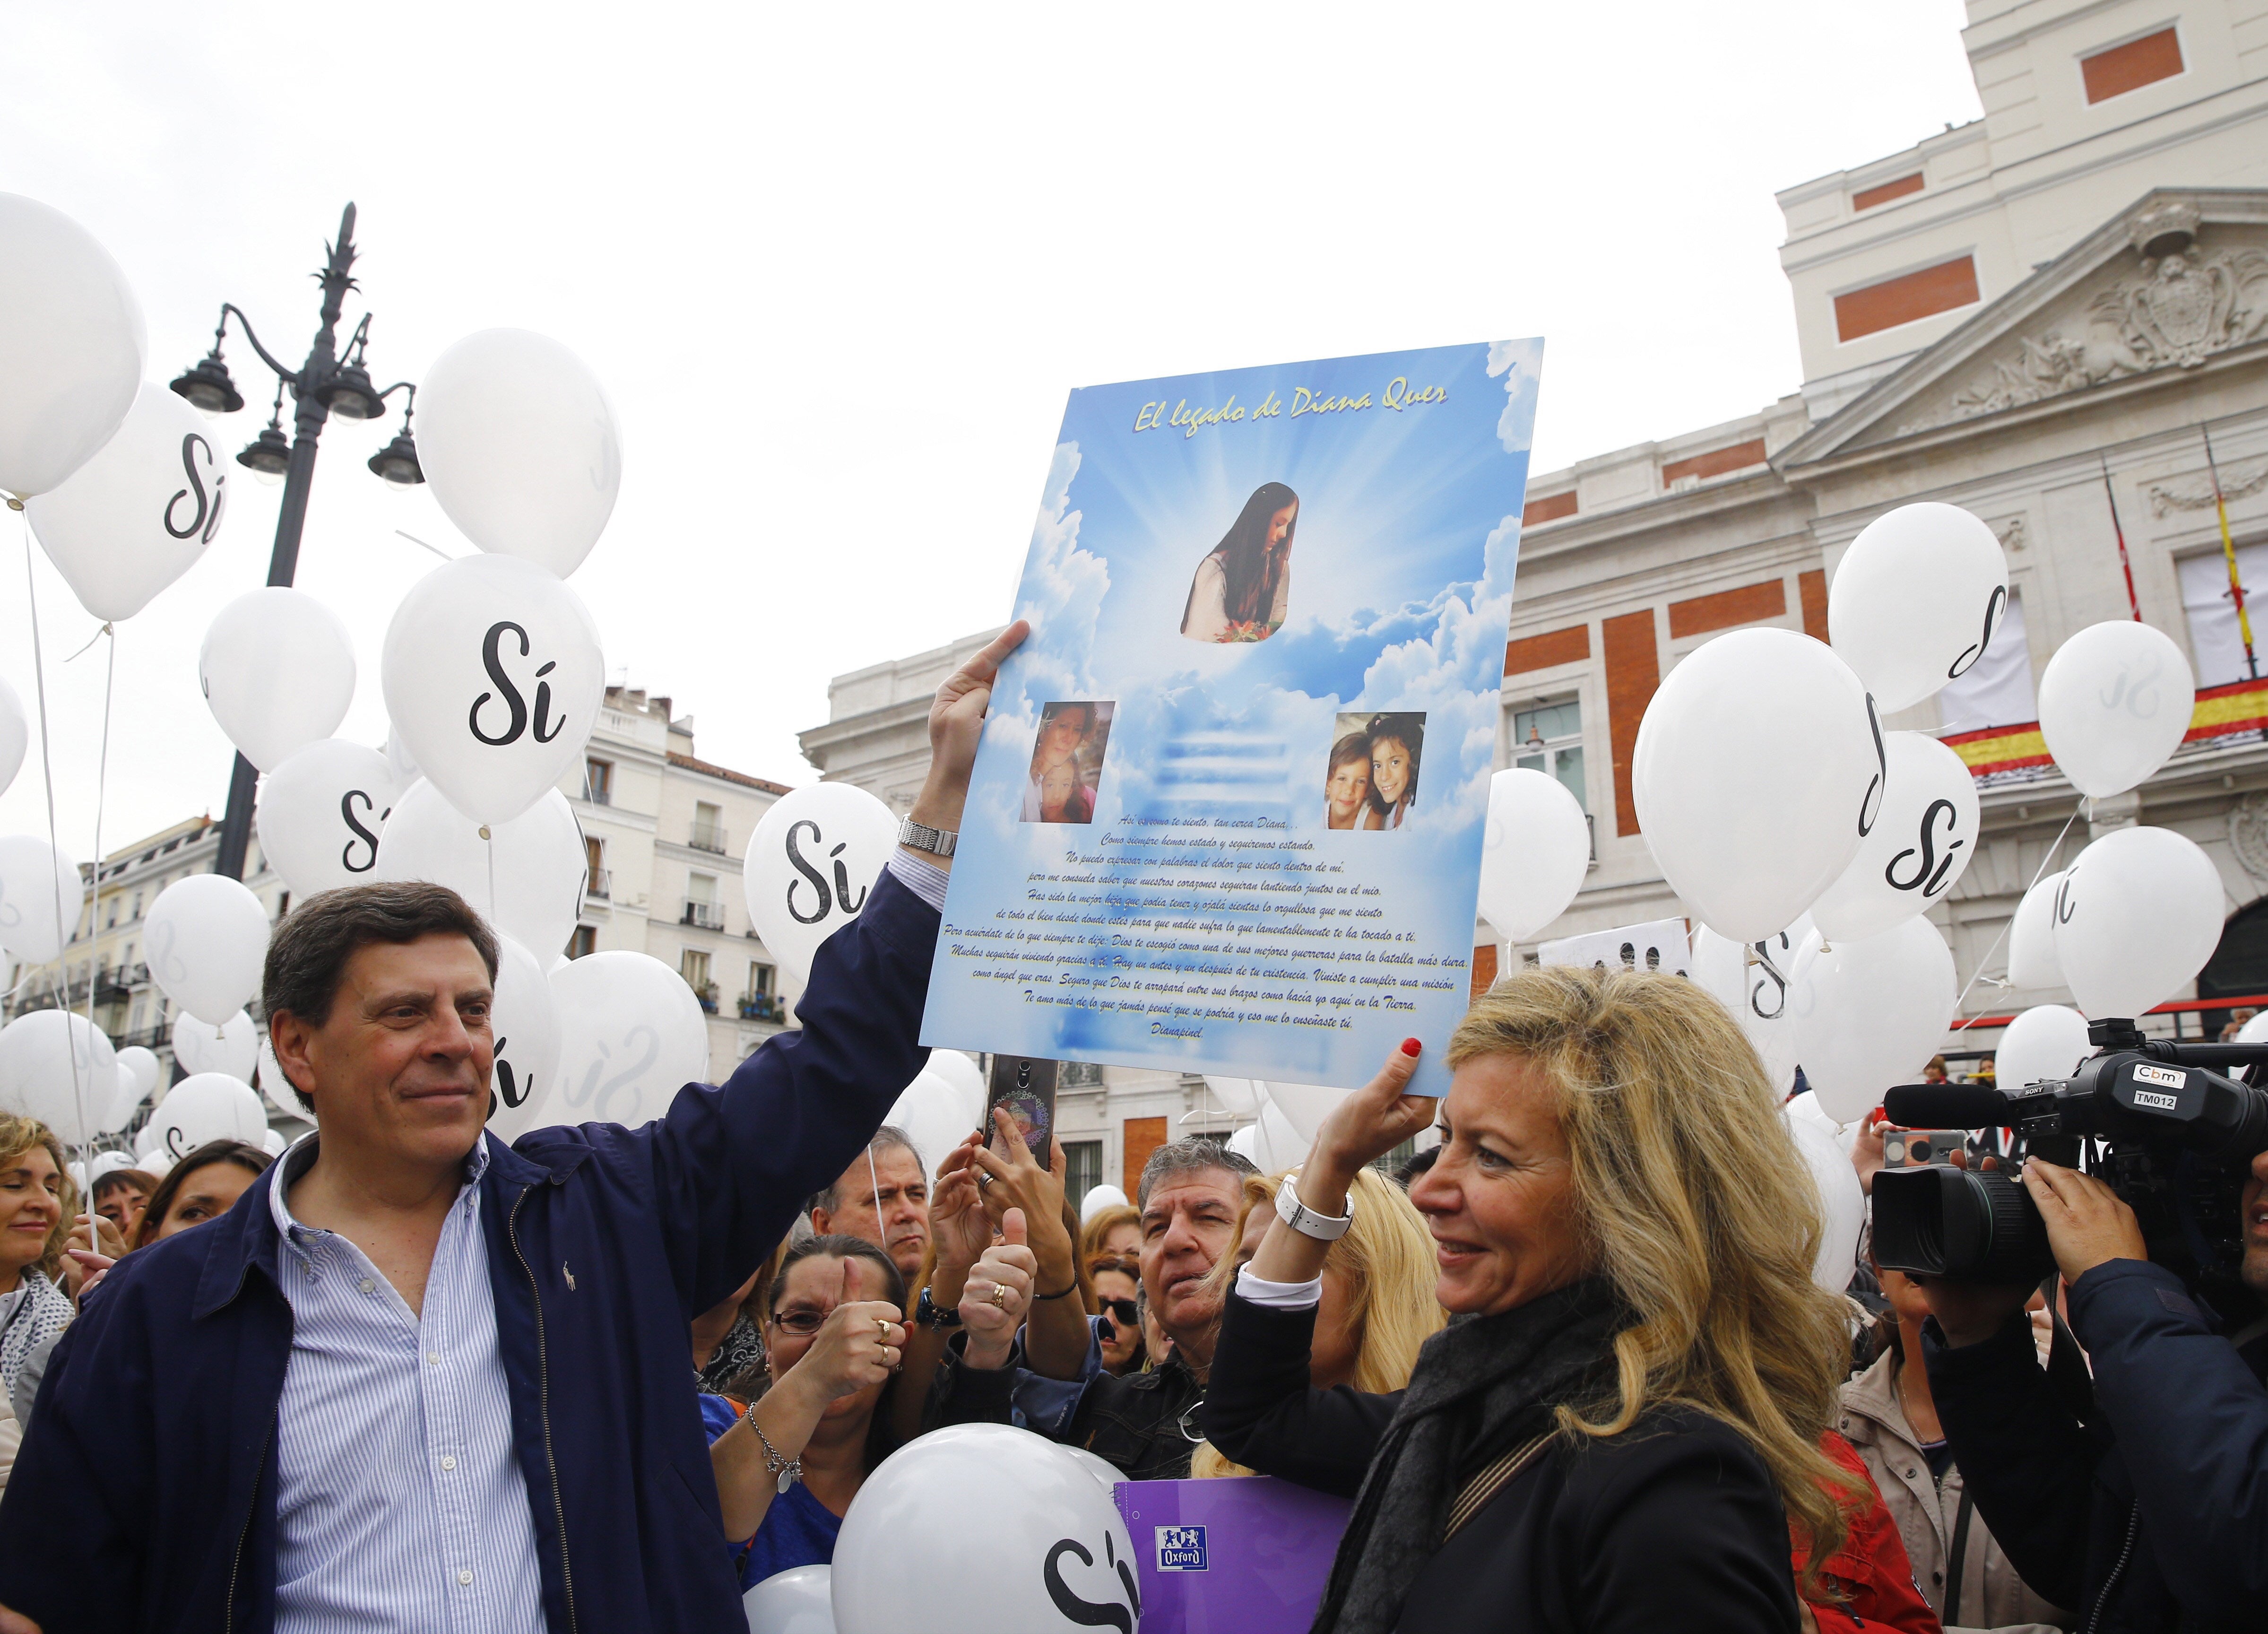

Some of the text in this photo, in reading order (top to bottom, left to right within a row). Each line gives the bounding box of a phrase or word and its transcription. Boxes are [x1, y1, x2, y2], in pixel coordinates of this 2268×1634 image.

[1134, 377, 1448, 439] El legado de Diana Quer
[469, 621, 566, 746] Sí
[341, 790, 390, 872] S
[1119, 814, 1137, 825] Así
[1182, 817, 1209, 827] siento,
[1213, 817, 1230, 827] tan
[1231, 820, 1255, 828] cerca
[1101, 832, 1124, 845] Como
[1126, 835, 1160, 848] siempre
[1161, 834, 1187, 846] hemos
[1189, 836, 1217, 847] estado
[1229, 839, 1276, 852] seguiremos
[1885, 799, 1964, 898] Sí
[786, 820, 867, 924] Sí
[1065, 850, 1078, 863] No
[1078, 853, 1105, 866] puedo
[1107, 855, 1142, 868] expresar
[1158, 855, 1198, 869] palabras
[1211, 857, 1234, 869] dolor
[1236, 861, 1253, 873] que
[1255, 860, 1281, 870] siento
[1283, 860, 1312, 871] dentro
[1315, 860, 1327, 872] de
[1028, 873, 1046, 883] pero
[1062, 872, 1096, 883] consuela
[1098, 872, 1120, 884] saber
[1122, 877, 1138, 889] que
[1140, 877, 1174, 887] nuestros
[1177, 880, 1217, 892] corazones
[1260, 879, 1302, 893] lantiendo
[1303, 882, 1333, 896] juntos
[1336, 887, 1348, 895] en
[1350, 883, 1361, 895] el
[1028, 888, 1046, 901] Has
[1047, 891, 1065, 902] sido
[1067, 891, 1076, 903] la
[1079, 894, 1102, 907] mejor
[1169, 898, 1191, 909] tener
[1202, 898, 1227, 912] ojalá
[1228, 901, 1260, 912] sientas
[1274, 902, 1316, 917] orgullosa
[1319, 907, 1336, 920] que
[1355, 907, 1383, 918] siento
[996, 908, 1006, 919] de
[1008, 909, 1025, 920] todo
[1037, 909, 1054, 921] bien
[1056, 911, 1080, 923] desde
[1081, 913, 1106, 924] donde
[1108, 913, 1128, 925] estés
[1129, 917, 1152, 929] para
[1154, 920, 1170, 932] que
[1172, 918, 1197, 930] nadie
[1199, 919, 1223, 935] sufra
[1237, 925, 1254, 937] que
[1256, 921, 1331, 937] lamentablemente
[1333, 928, 1343, 938] te
[1345, 925, 1358, 939] ha
[1361, 929, 1392, 940] tocado
[944, 923, 963, 936] Pero
[965, 926, 1003, 939] acuérdate
[1004, 929, 1015, 939] de
[1017, 929, 1025, 940] lo
[1027, 933, 1042, 945] que
[1043, 932, 1075, 946] siempre
[1088, 933, 1109, 948] dije:
[1111, 934, 1132, 947] Dios
[1146, 938, 1177, 953] escogió
[1178, 943, 1200, 951] como
[1202, 944, 1220, 952] una
[1222, 942, 1234, 953] de
[1236, 946, 1251, 954] sus
[1254, 945, 1289, 959] mejores
[1291, 949, 1335, 961] guerreras
[1337, 951, 1362, 963] para
[1378, 950, 1414, 965] batalla
[1417, 953, 1438, 966] más
[952, 943, 983, 957] Muchas
[985, 948, 1020, 962] seguirán
[1021, 951, 1054, 962] viviendo
[1056, 955, 1088, 967] gracias
[1112, 955, 1133, 969] Hay
[1135, 961, 1147, 969] un
[1149, 960, 1172, 971] antes
[1183, 964, 1196, 973] un
[1198, 962, 1233, 977] después
[1236, 965, 1247, 976] de
[1250, 966, 1260, 977] tu
[1313, 968, 1347, 983] Viniste
[1359, 973, 1397, 989] cumplir
[1400, 979, 1419, 988] una
[1421, 977, 1454, 990] misión
[972, 970, 992, 978] como
[994, 967, 1018, 983] ángel
[1017, 973, 1033, 984] que
[1059, 973, 1090, 989] Seguro
[1092, 979, 1108, 991] que
[1110, 975, 1131, 989] Dios
[1133, 980, 1143, 990] te
[1144, 981, 1186, 995] arropará
[1186, 984, 1209, 995] entre
[1211, 987, 1227, 996] sus
[1229, 984, 1258, 1002] brazos
[1261, 991, 1283, 1000] como
[1286, 989, 1312, 1003] hacía
[1330, 993, 1353, 1009] aquí
[1354, 999, 1366, 1007] en
[1368, 995, 1380, 1008] la
[1024, 990, 1035, 1002] Te
[1036, 995, 1054, 1004] amo
[1056, 994, 1074, 1005] más
[1099, 1000, 1116, 1012] que
[1117, 1000, 1145, 1012] jamás
[1146, 1002, 1173, 1015] pensé
[1174, 1007, 1190, 1018] que
[1192, 1008, 1203, 1016] se
[1203, 1007, 1235, 1020] podría
[1247, 1012, 1262, 1021] eso
[1264, 1015, 1278, 1023] me
[1281, 1011, 1290, 1023] lo
[1293, 1014, 1337, 1027] enseñaste
[2139, 1067, 2176, 1082] Cbm
[2025, 1087, 2044, 1095] SONY
[2137, 1093, 2174, 1107] TM012
[1165, 1549, 1200, 1565] Oxford
